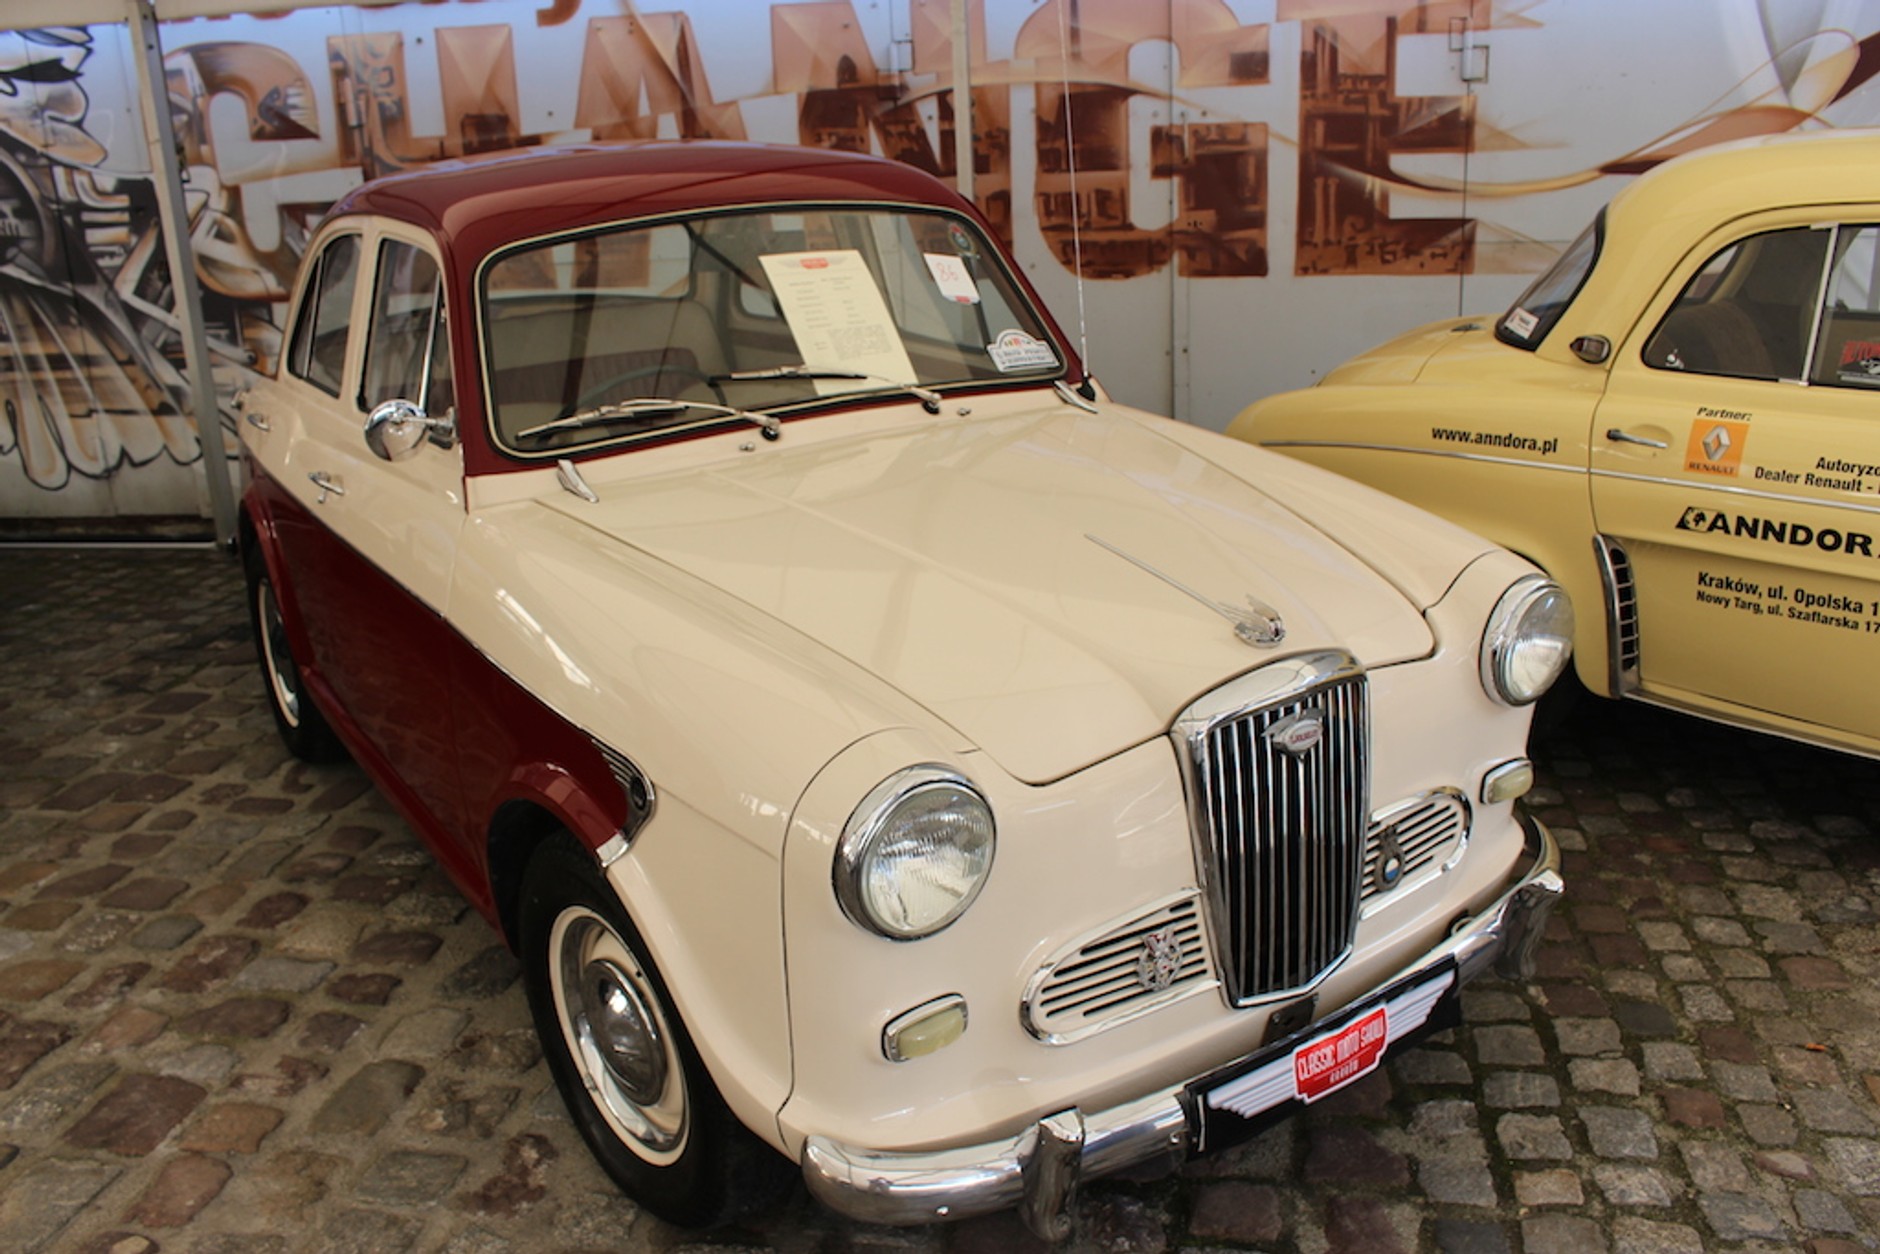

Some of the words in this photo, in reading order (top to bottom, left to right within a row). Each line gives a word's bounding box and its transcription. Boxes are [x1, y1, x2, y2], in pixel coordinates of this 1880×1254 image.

[1697, 406, 1752, 422] Partner:
[1431, 427, 1558, 455] www.anndora.pl
[1689, 461, 1736, 476] RENAULT
[1754, 466, 1801, 484] Dealer
[1804, 473, 1863, 492] Renault
[1707, 511, 1880, 558] ANNDOR
[1698, 571, 1762, 600] Kraków,
[1767, 584, 1788, 601] ul.
[1794, 588, 1863, 614] Opolska
[1696, 590, 1731, 609] Nowy
[1734, 596, 1764, 615] Targ,
[1767, 603, 1784, 617] ul.
[1788, 606, 1859, 631] Szaflarska
[1298, 1044, 1335, 1081] CLASSIC
